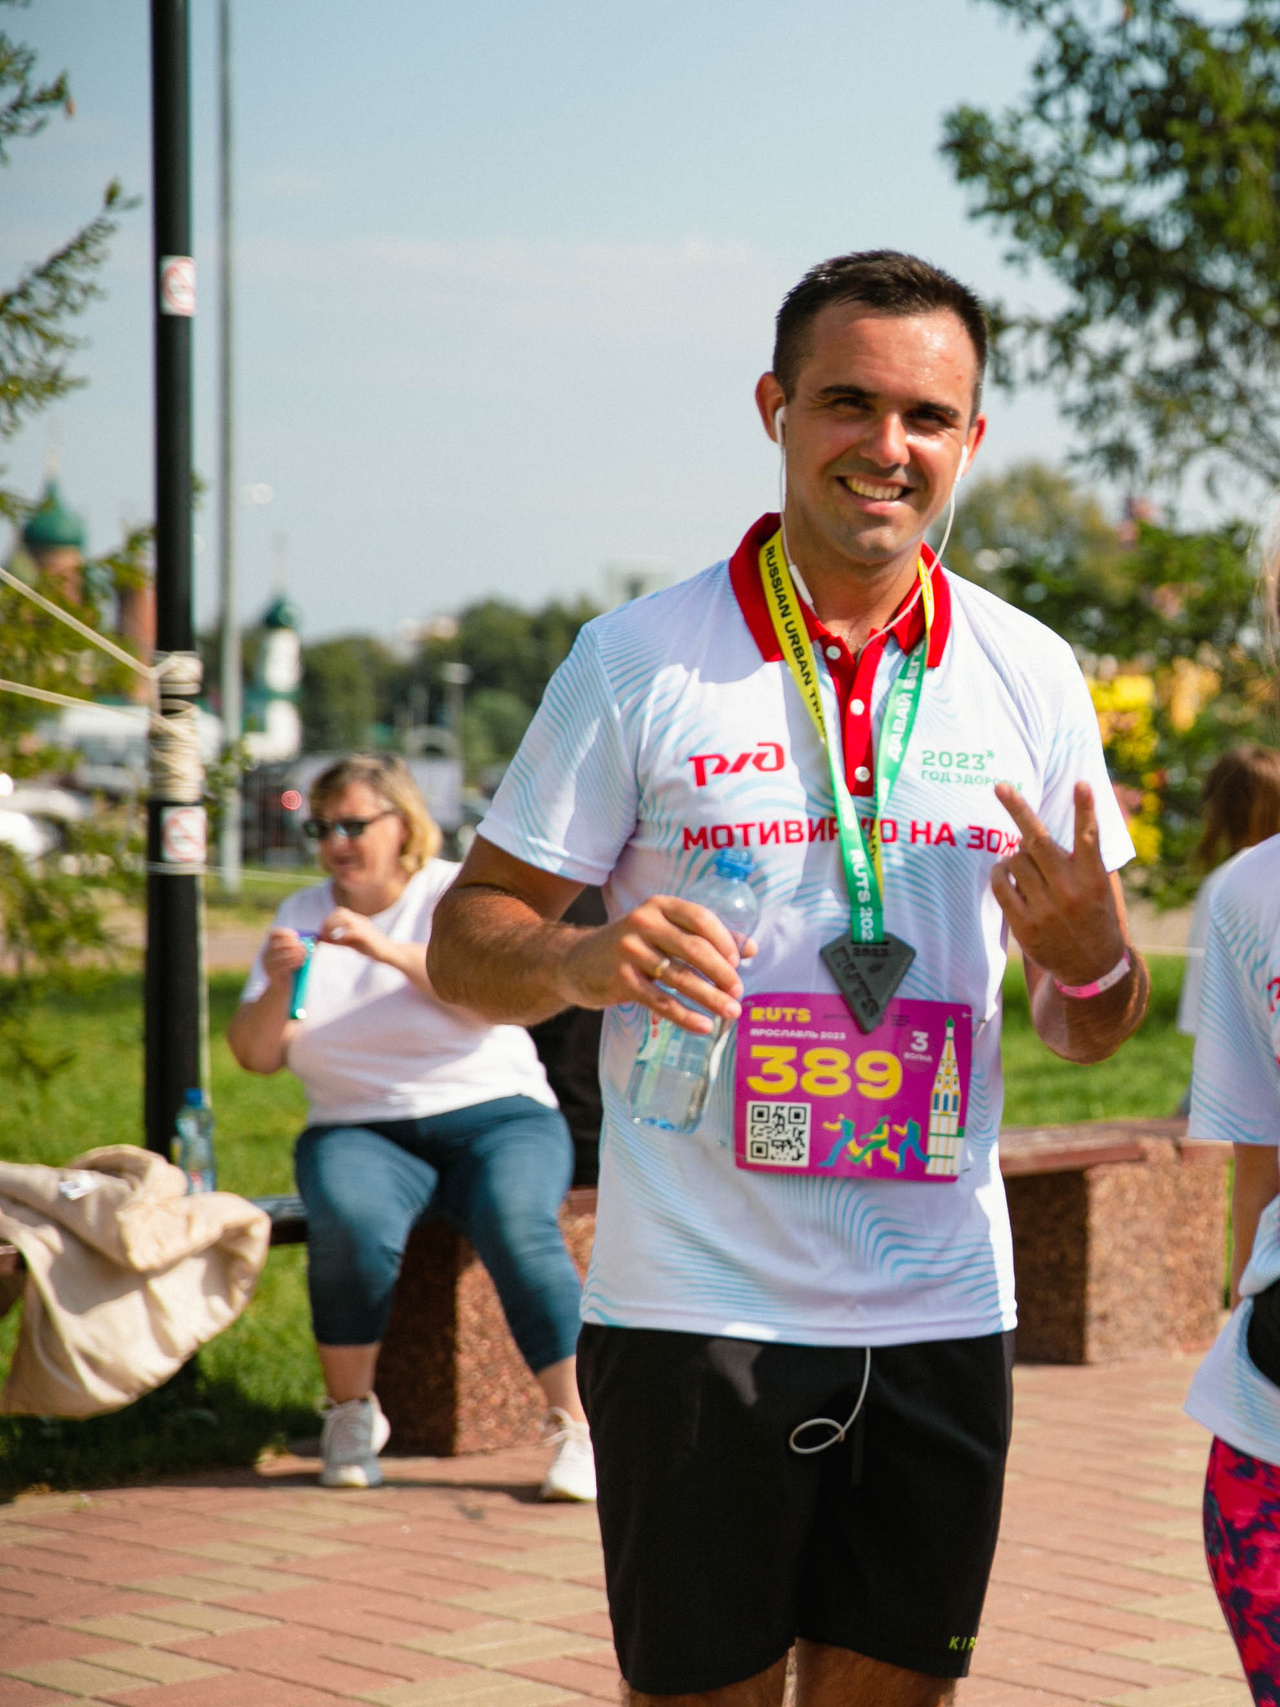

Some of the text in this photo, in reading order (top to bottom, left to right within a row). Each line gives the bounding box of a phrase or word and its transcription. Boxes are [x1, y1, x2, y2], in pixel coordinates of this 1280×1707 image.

[765, 545, 827, 738] RUSSIAN URBAN TRA
[887, 638, 926, 763] ДАВАЙ БЕГО
[921, 750, 986, 770] 2023
[921, 769, 1023, 792] ГОД ЗДОРОЯ
[682, 815, 898, 851] МОТИВИРЮ
[910, 820, 957, 848] НА
[966, 825, 1021, 857] ЗОЖ
[850, 849, 871, 904] RUTS
[859, 905, 875, 943] 202
[751, 1006, 812, 1023] RUTS
[750, 1028, 847, 1041] ЯРОСЛАВЛЬ 2023
[910, 1030, 930, 1052] 3
[746, 1044, 904, 1100] 389
[903, 1051, 933, 1064] ВОЛНА
